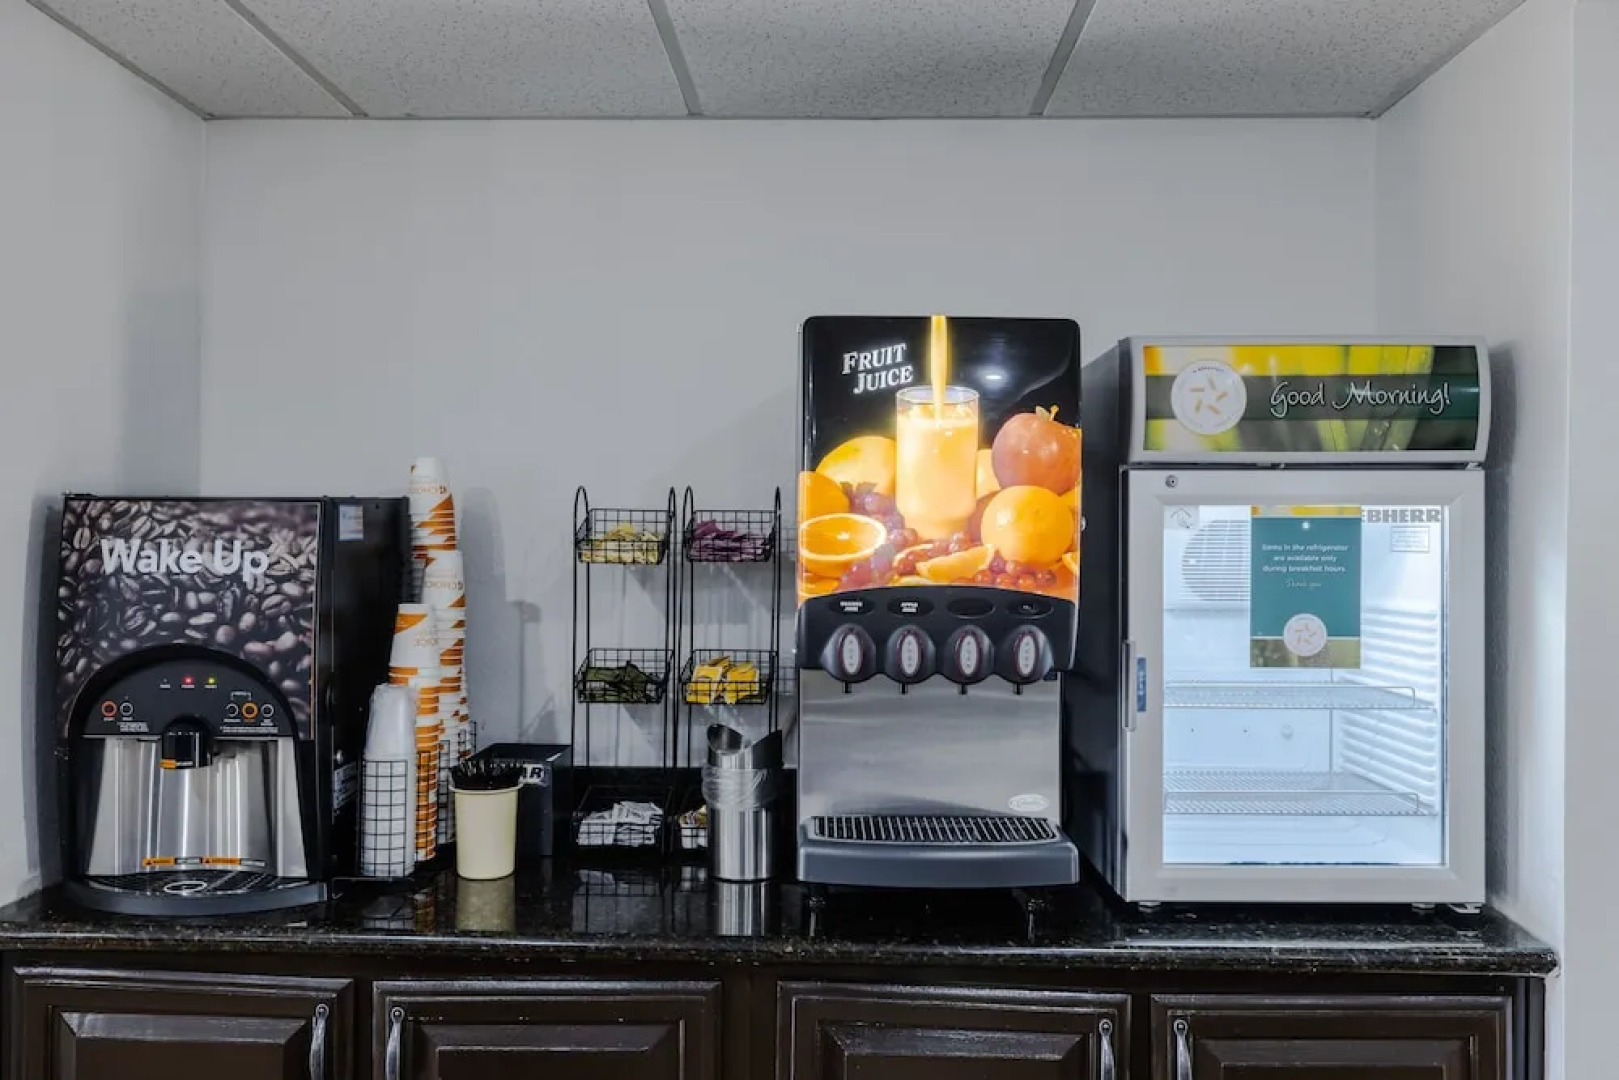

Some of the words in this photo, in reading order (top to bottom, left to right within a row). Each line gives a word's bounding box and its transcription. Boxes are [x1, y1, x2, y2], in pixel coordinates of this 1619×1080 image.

[841, 342, 907, 375] FRUIT
[853, 364, 914, 395] JUICE
[1270, 381, 1325, 418] Good
[1332, 380, 1451, 415] Morning!
[101, 537, 203, 576] Wake
[214, 538, 268, 582] Up
